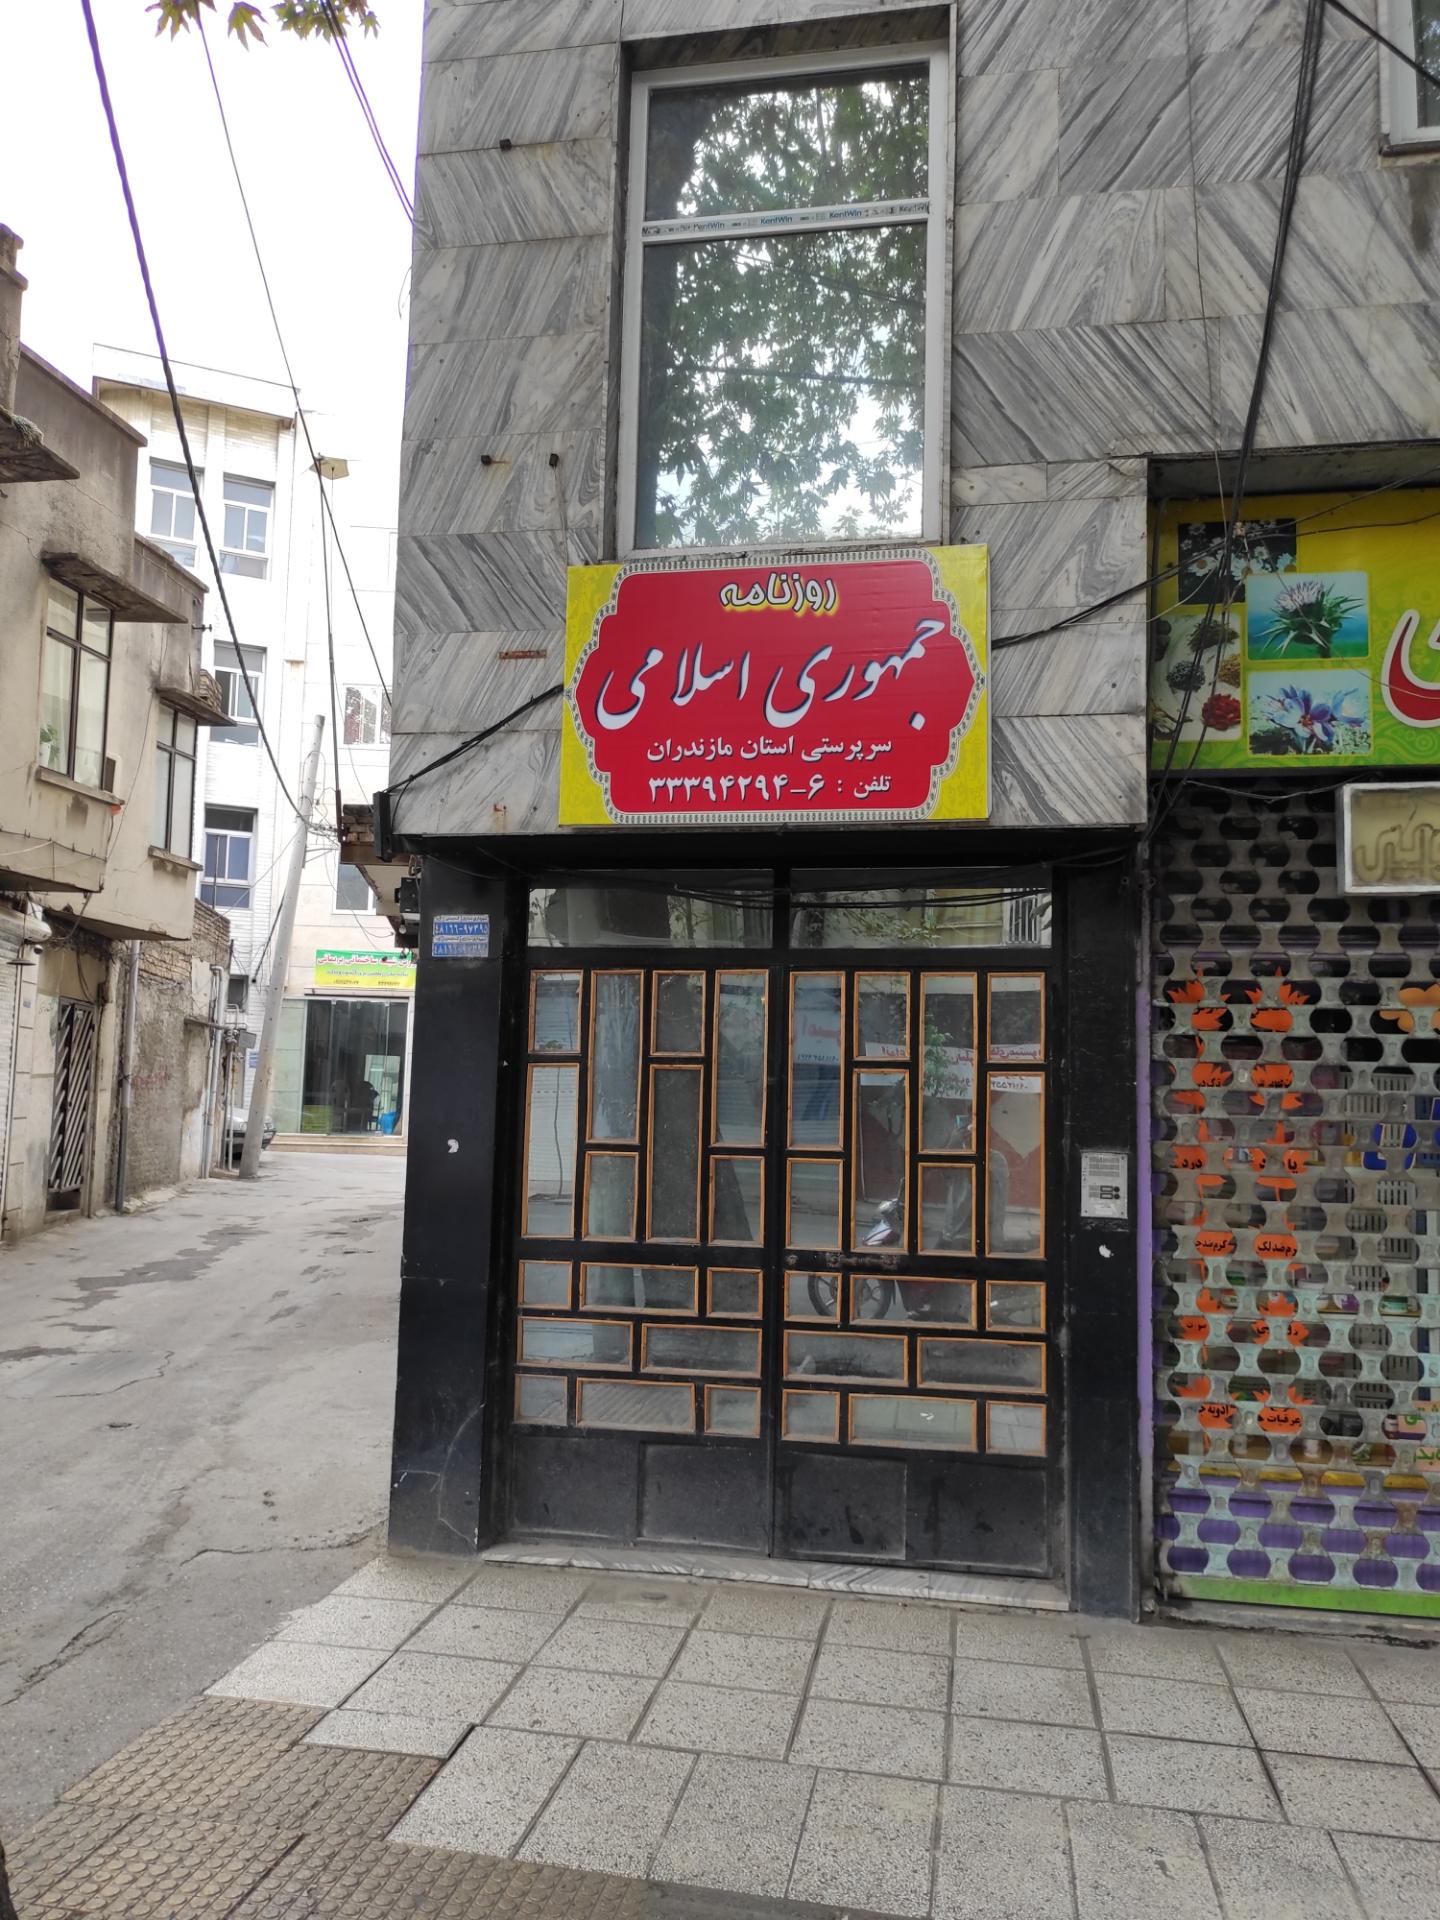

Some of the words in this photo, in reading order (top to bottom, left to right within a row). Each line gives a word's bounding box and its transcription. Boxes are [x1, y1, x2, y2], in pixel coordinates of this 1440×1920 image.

[760, 214, 793, 226] KentWin
[829, 208, 862, 220] KentWin
[720, 571, 838, 613] روزنامه
[595, 640, 750, 730] اسلامی
[764, 618, 946, 731] جمهوری
[646, 740, 733, 762] مازندران
[739, 736, 795, 760] استان
[801, 739, 892, 762] سرپرستی
[648, 773, 825, 803] ۳۳۳۹۴۲۹۴-۶
